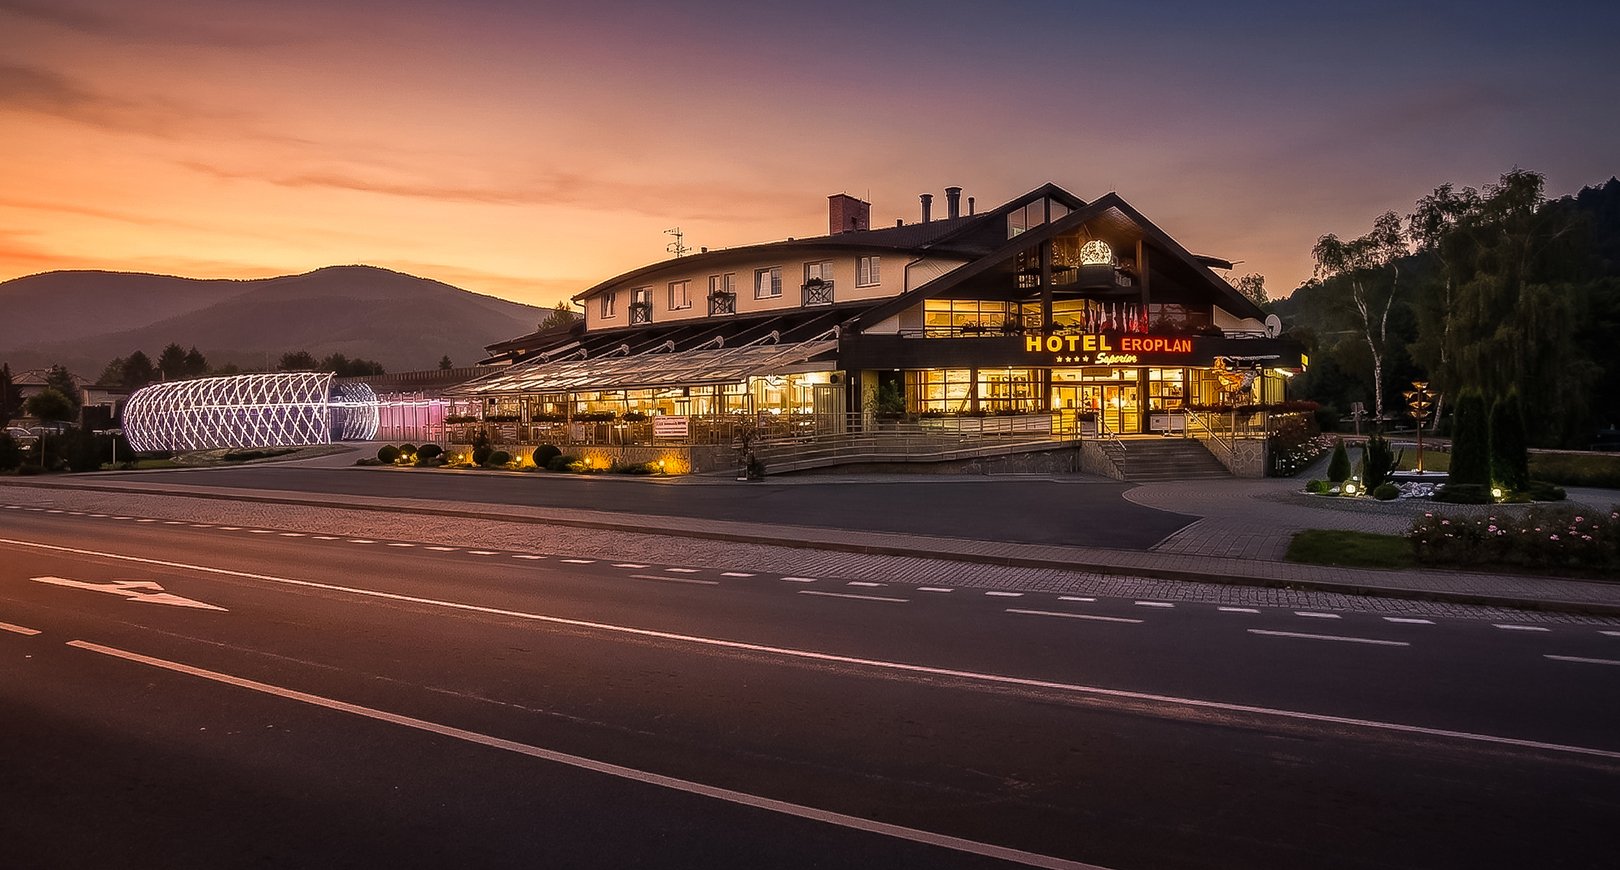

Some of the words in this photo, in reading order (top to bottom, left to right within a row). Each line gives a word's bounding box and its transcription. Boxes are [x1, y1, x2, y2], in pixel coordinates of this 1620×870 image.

[1026, 335, 1112, 352] HOTEL
[1121, 338, 1192, 353] EROPLAN
[1095, 352, 1138, 365] Superior
